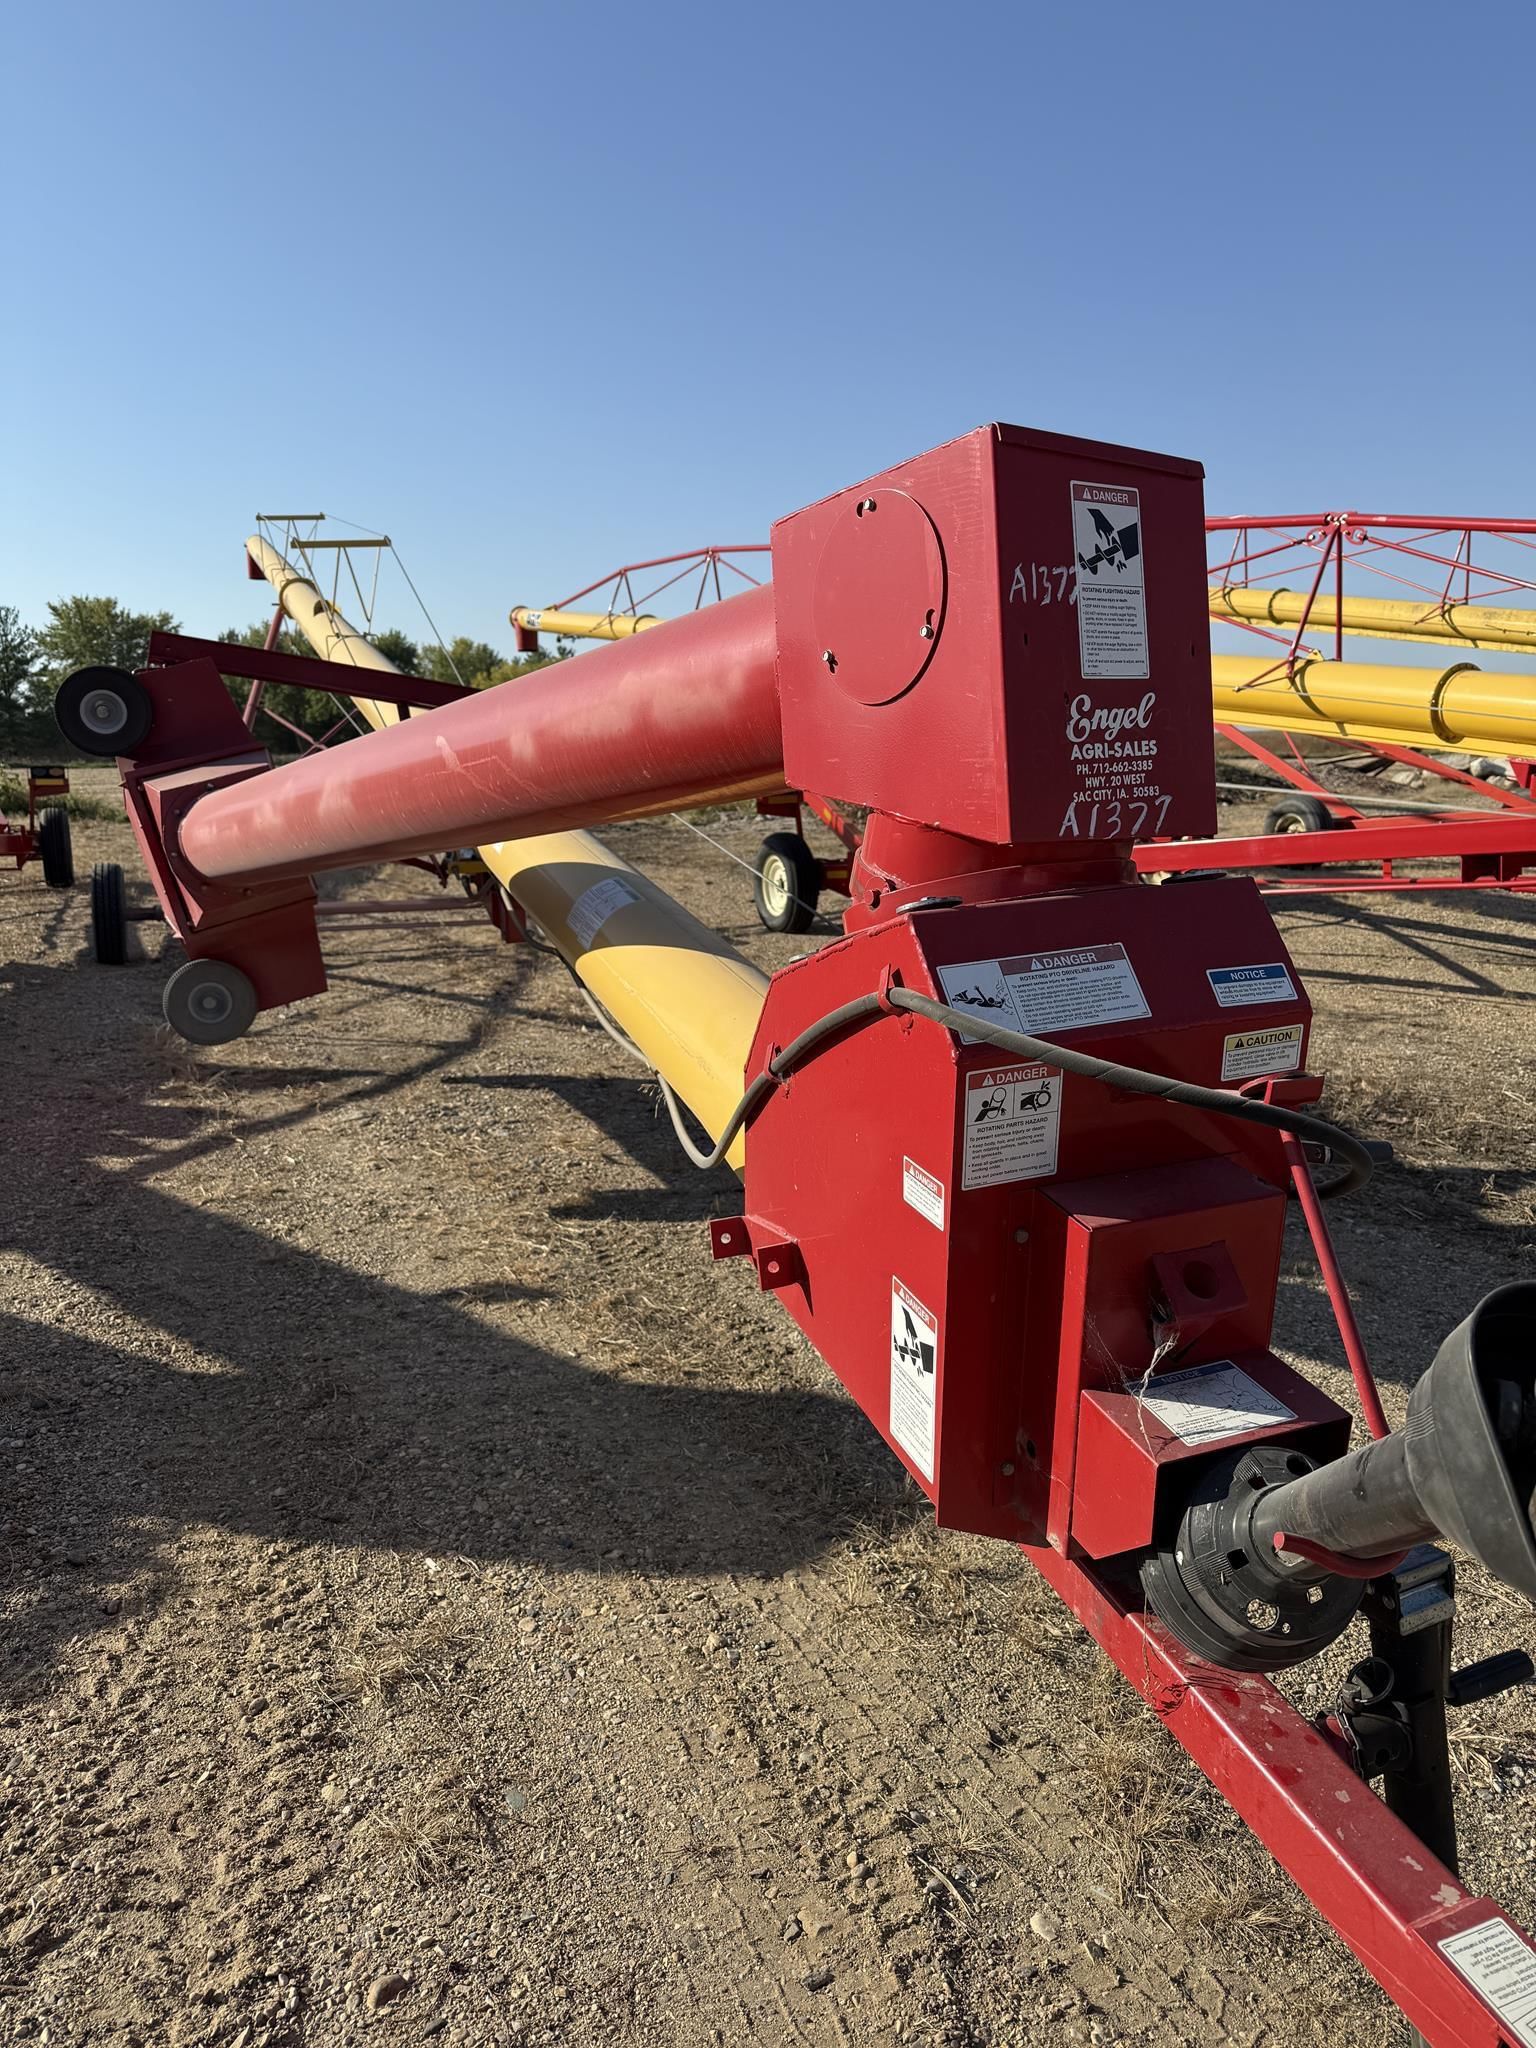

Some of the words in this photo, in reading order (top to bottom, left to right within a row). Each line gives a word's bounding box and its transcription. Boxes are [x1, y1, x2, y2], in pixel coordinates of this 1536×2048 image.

[1092, 490, 1129, 504] DANGER
[1066, 692, 1156, 742] Engel
[1071, 740, 1158, 760] AGRI-SALES
[1076, 764, 1092, 775] PH.
[1093, 760, 1153, 774] 712-662-3385
[1085, 777, 1109, 788] HWY.
[1110, 775, 1122, 786] 20
[1123, 773, 1146, 785] WEST
[1073, 791, 1091, 803] SAC
[1093, 789, 1116, 801] CITY,
[1117, 787, 1129, 799] IA.
[1133, 785, 1160, 798] 50583
[1058, 795, 1173, 839] A1377
[1042, 952, 1098, 969] DANGER
[1019, 973, 1048, 982] ROTATING
[1061, 966, 1091, 976] DRIVELINE
[1090, 963, 1115, 971] HAZARD
[1230, 969, 1267, 981] NOTICE
[1246, 1031, 1293, 1047] CAUTION
[996, 1066, 1048, 1084] DANGER
[976, 1123, 1005, 1133] ROTATING
[1006, 1120, 1024, 1128] PARTS
[1025, 1115, 1048, 1125] HAZARD
[1161, 1369, 1203, 1384] NOTICE
